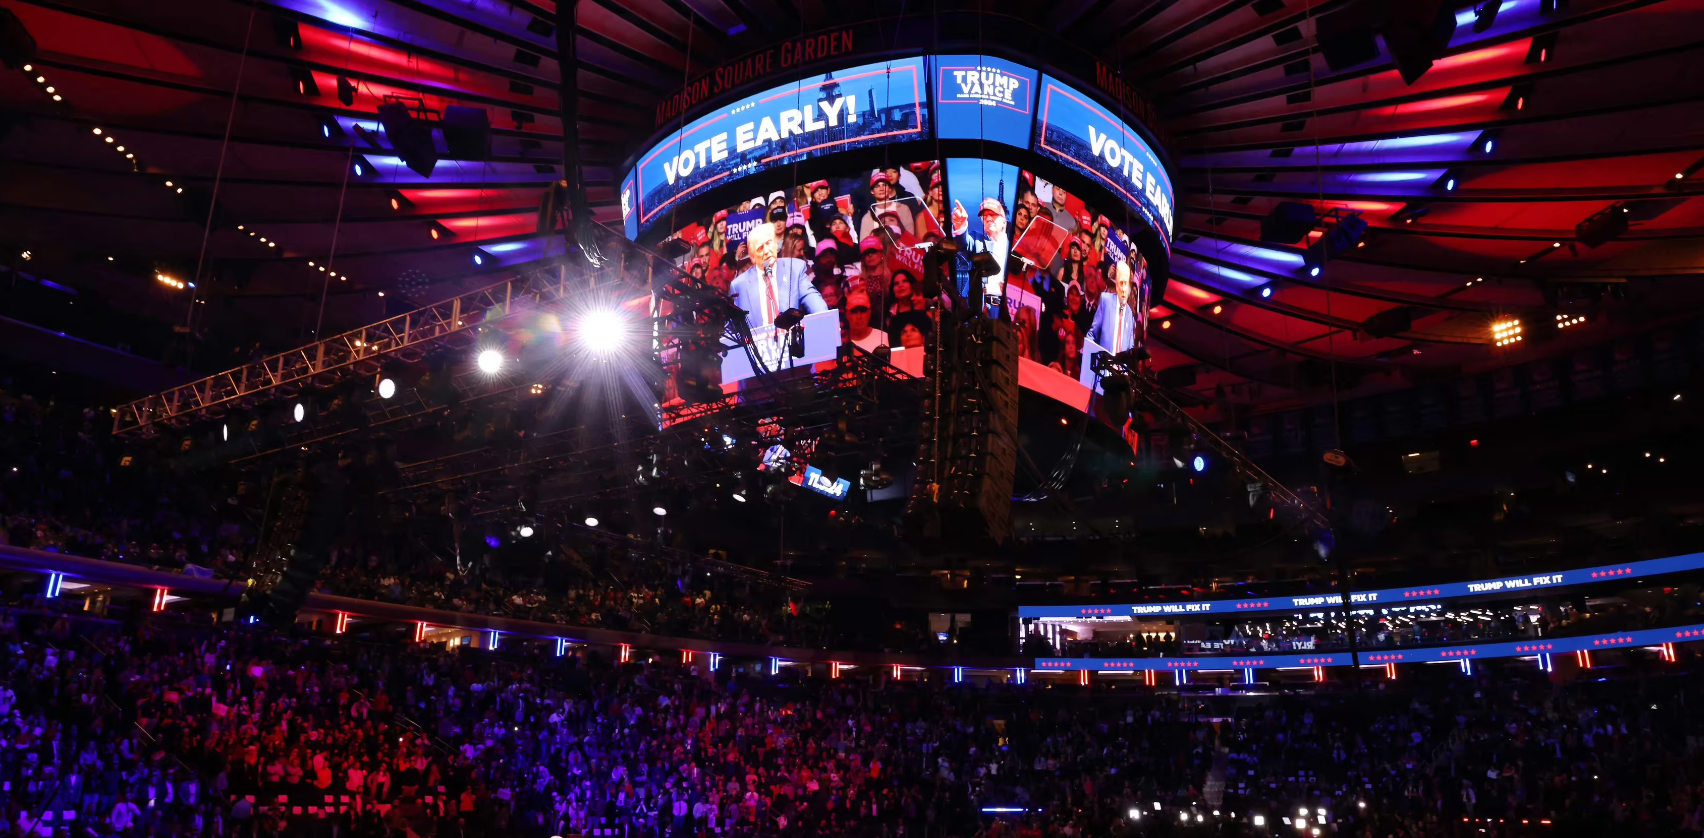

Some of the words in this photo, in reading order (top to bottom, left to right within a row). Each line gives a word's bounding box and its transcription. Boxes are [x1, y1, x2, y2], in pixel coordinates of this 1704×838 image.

[655, 76, 709, 127] MADISON
[713, 50, 775, 93] SQUARE
[780, 29, 854, 68] GARDEN
[953, 70, 1020, 91] TRUMP
[960, 83, 1013, 101] VANCE
[663, 131, 729, 186] VOTE
[735, 94, 858, 153] EARLY!
[1088, 125, 1144, 190] VOTE
[1467, 581, 1504, 592] TRUMP
[1504, 578, 1532, 589] WILL
[1532, 576, 1551, 586] FIX
[1552, 574, 1563, 584] IT
[1131, 605, 1162, 614] TRUMP
[1163, 604, 1185, 613] WILL
[1186, 603, 1201, 612] FIX
[1202, 603, 1211, 611] IT
[1292, 596, 1325, 607] TRUMP
[1350, 593, 1367, 603] FIX
[1368, 592, 1378, 601] IT
